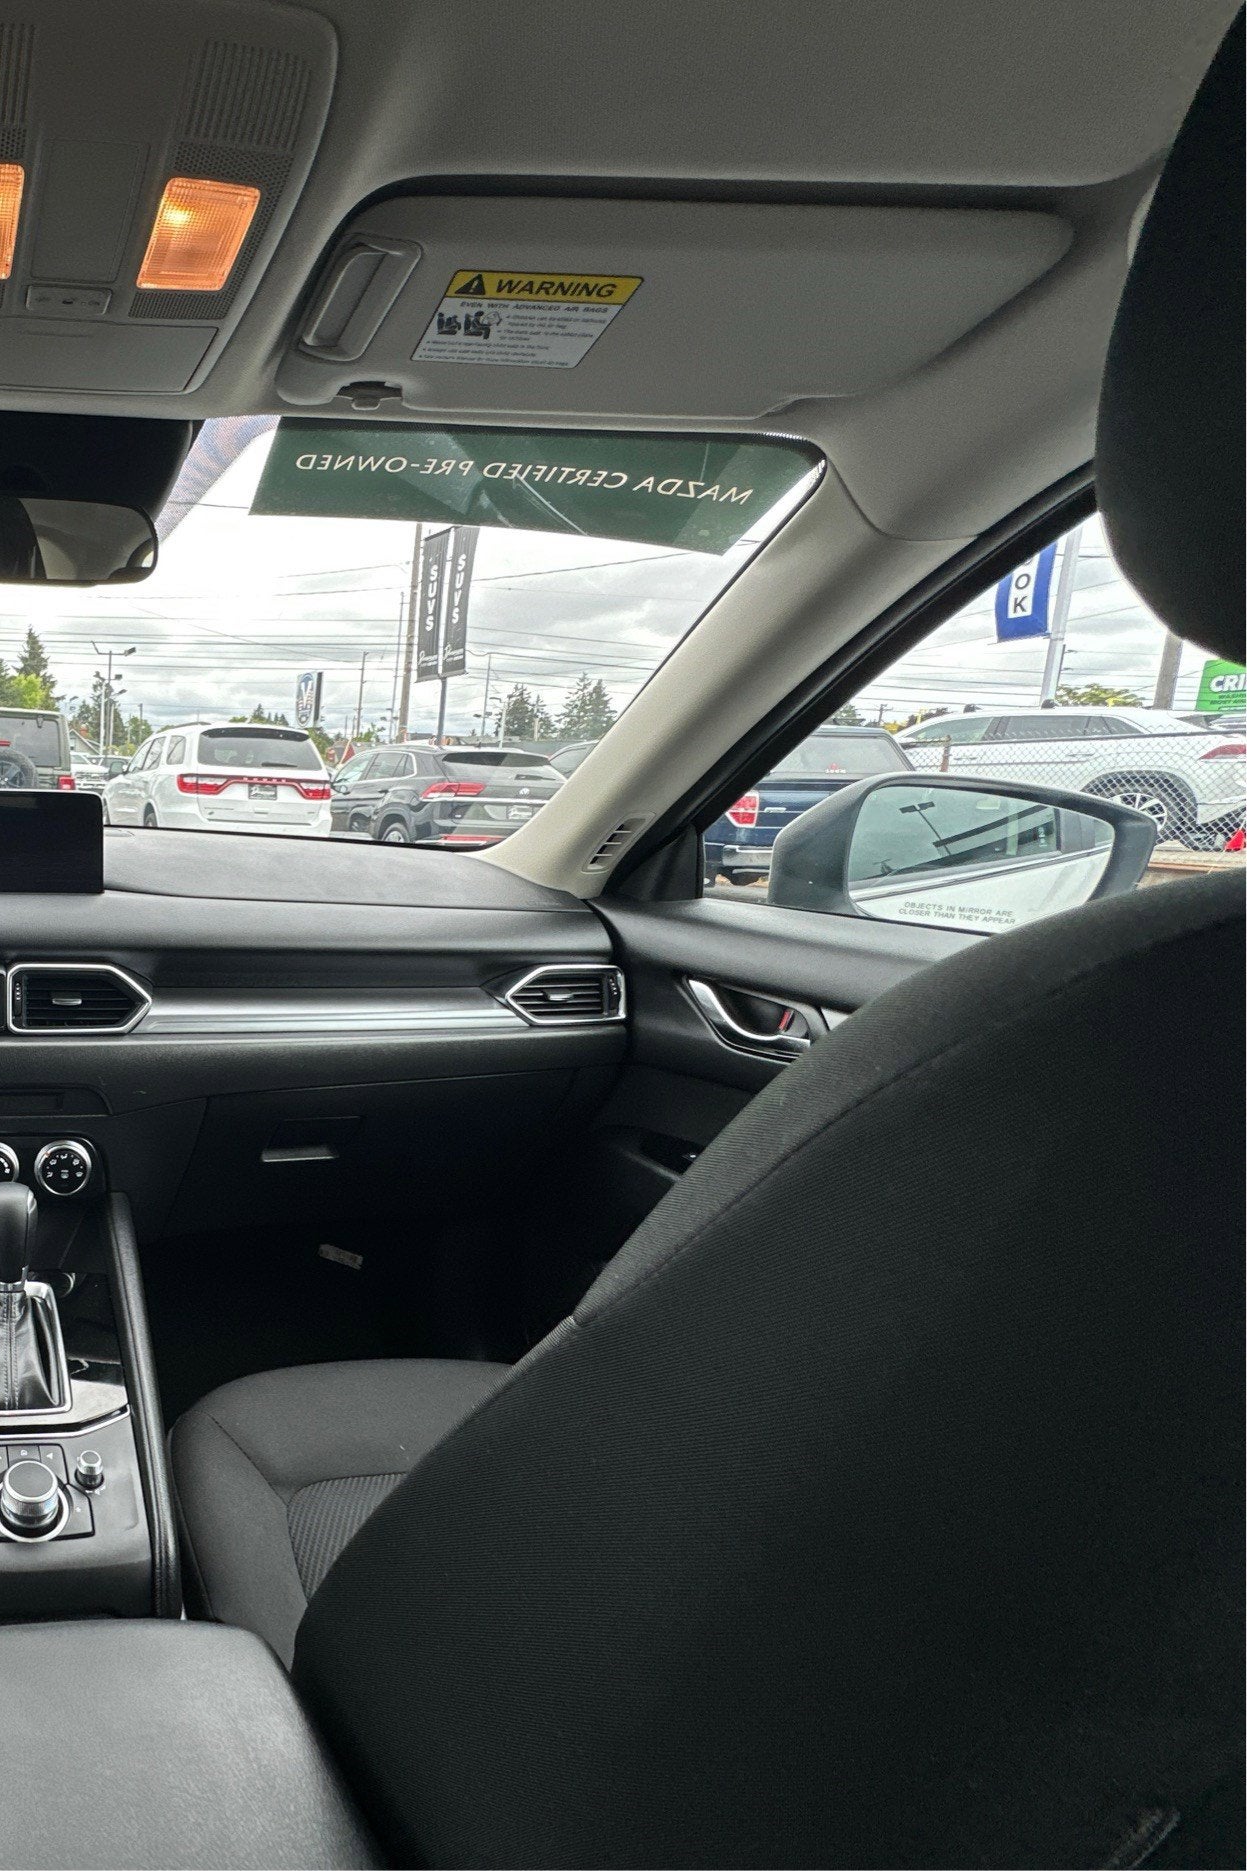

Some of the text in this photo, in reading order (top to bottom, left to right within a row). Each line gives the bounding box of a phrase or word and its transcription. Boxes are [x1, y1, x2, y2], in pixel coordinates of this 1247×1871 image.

[496, 279, 617, 298] WARNING
[513, 303, 560, 312] ADVANCED
[452, 554, 467, 624] SUVS
[425, 565, 438, 632] SUVS
[1210, 674, 1246, 692] CRI
[899, 908, 930, 916] CLOSER
[983, 916, 1015, 924] APPEAR
[904, 901, 943, 911] OBJECTS
[958, 907, 993, 915] MIRROR
